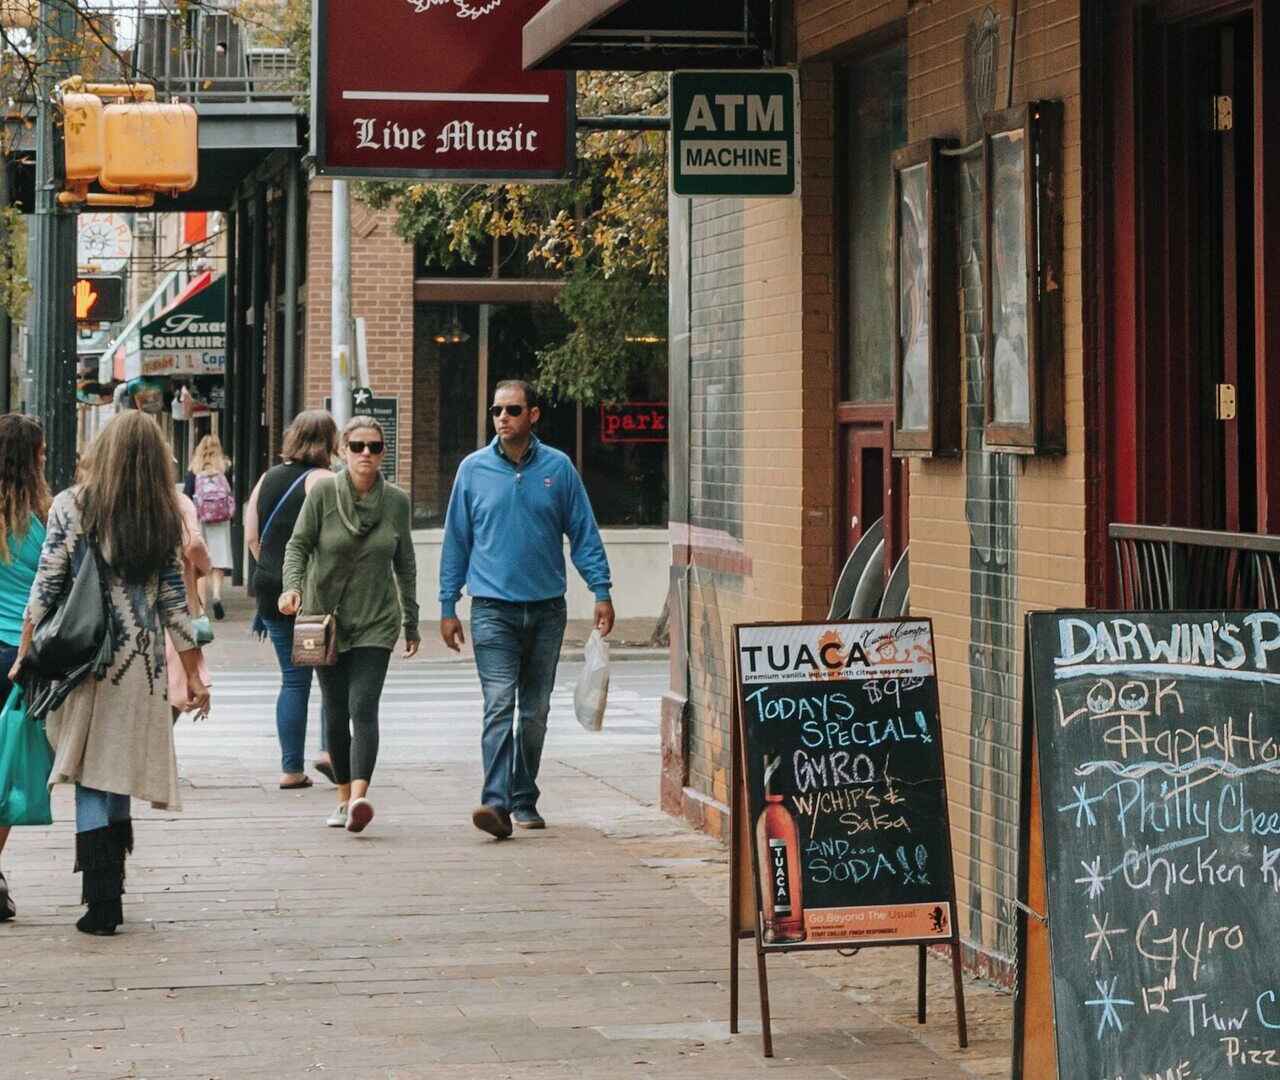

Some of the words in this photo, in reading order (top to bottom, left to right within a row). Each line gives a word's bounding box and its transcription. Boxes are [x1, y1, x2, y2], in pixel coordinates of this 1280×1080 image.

[684, 94, 784, 132] ATM
[353, 119, 426, 151] Live
[435, 120, 539, 154] Music
[686, 147, 781, 168] MACHINE
[742, 642, 872, 672] TUACA
[1054, 618, 1247, 670] DARWIN'S
[781, 671, 806, 679] vanilla
[1055, 678, 1184, 727] LOOK
[793, 750, 875, 793] GYRO
[1103, 775, 1210, 844] Philly
[774, 847, 787, 897] TUACA
[809, 914, 823, 923] Go
[827, 912, 864, 923] Beyond
[869, 911, 886, 920] The
[1135, 910, 1245, 980] Gyro
